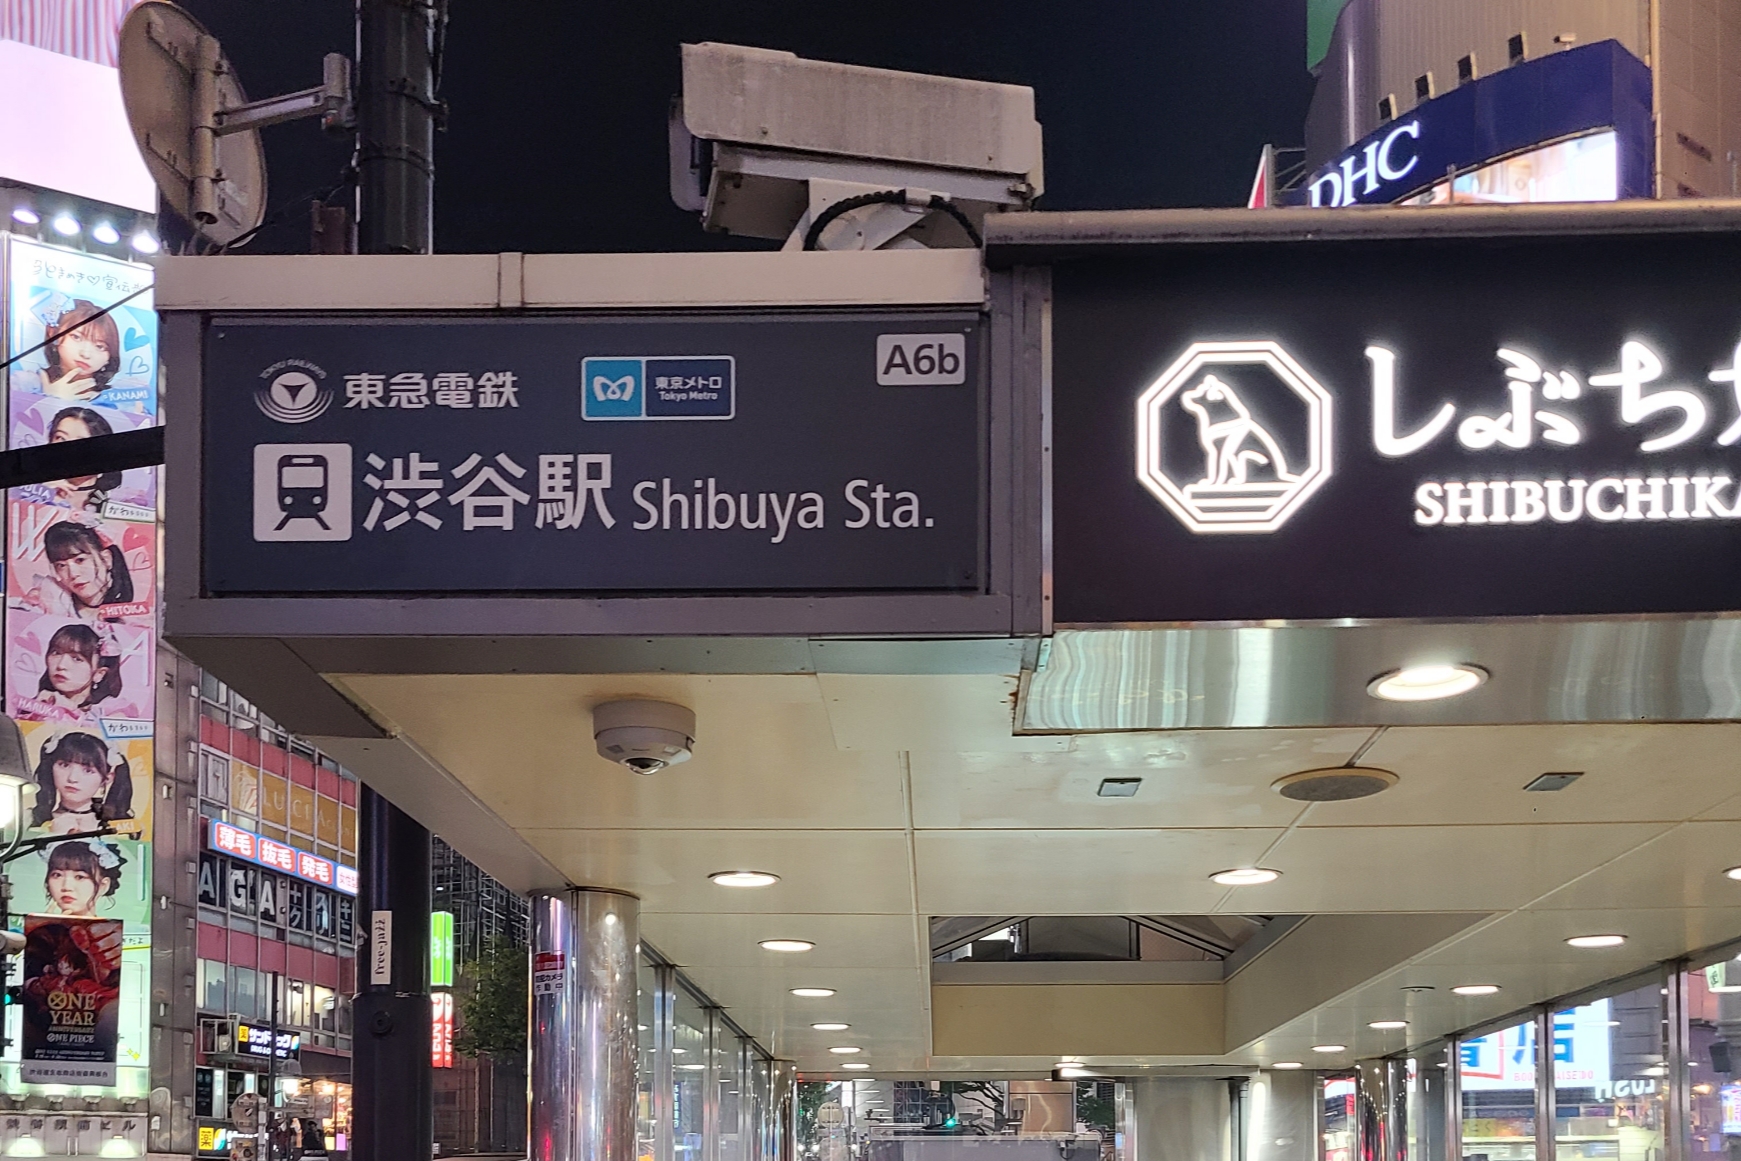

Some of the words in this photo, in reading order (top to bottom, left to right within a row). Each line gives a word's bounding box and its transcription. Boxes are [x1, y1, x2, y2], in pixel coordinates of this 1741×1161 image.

[1308, 120, 1420, 208] DHC
[881, 343, 961, 376] A6b
[343, 371, 521, 409] 東急電鉄
[654, 375, 722, 390] 東京メトロ
[108, 390, 149, 401] KANAMI
[659, 390, 687, 402] Tokyo
[689, 390, 718, 401] Metro
[1366, 340, 1741, 457] しぶち
[362, 452, 617, 532] 渋谷駅
[631, 479, 826, 545] Shibuya
[844, 479, 936, 531] Sta.
[107, 604, 147, 615] HITOKA
[219, 826, 252, 856] 薄毛
[262, 841, 292, 871] 抜毛
[301, 855, 330, 883] 発毛
[47, 991, 96, 1010] ONE
[50, 1010, 96, 1026] YEAR
[69, 1034, 95, 1043] PIECE
[249, 1028, 292, 1048] サンドッグ
[1555, 1070, 1594, 1080] AISEIDO
